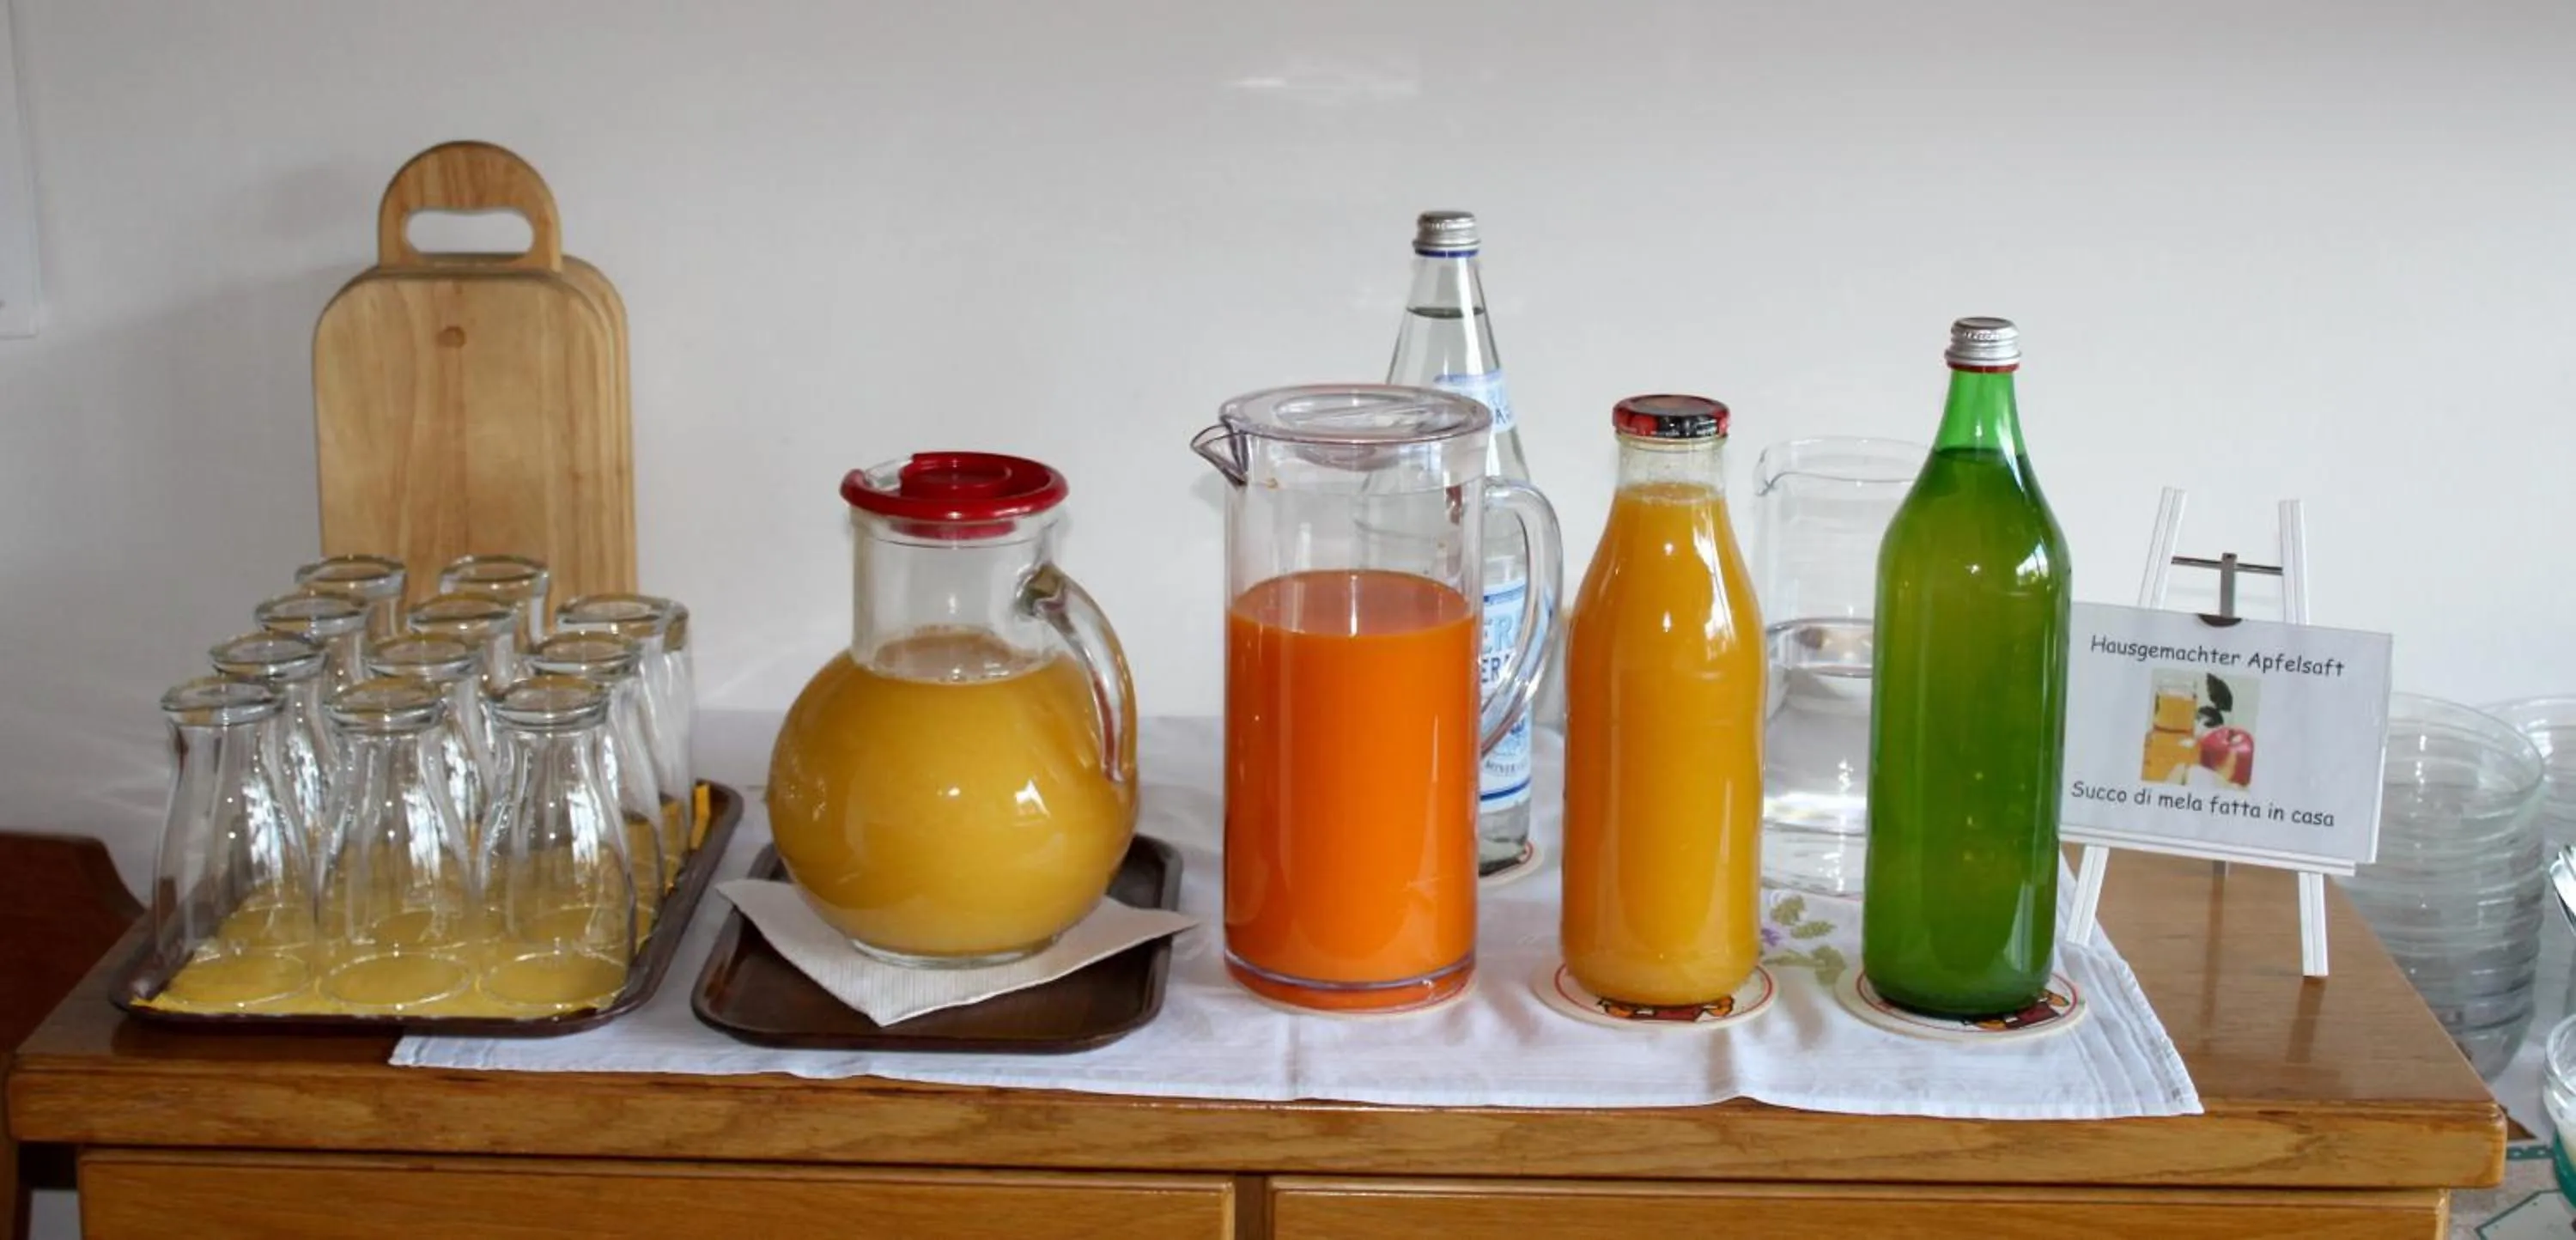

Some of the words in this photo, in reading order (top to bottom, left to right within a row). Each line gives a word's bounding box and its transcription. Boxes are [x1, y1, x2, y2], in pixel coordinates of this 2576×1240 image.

[2090, 635, 2240, 662] Hausgemachter
[2247, 652, 2346, 677] Apfelsaft
[2070, 780, 2128, 804] Succo
[2133, 787, 2152, 805] di
[2157, 792, 2203, 812] mela
[2208, 795, 2262, 819] fatta
[2267, 802, 2285, 822] in
[2290, 810, 2335, 828] casa
